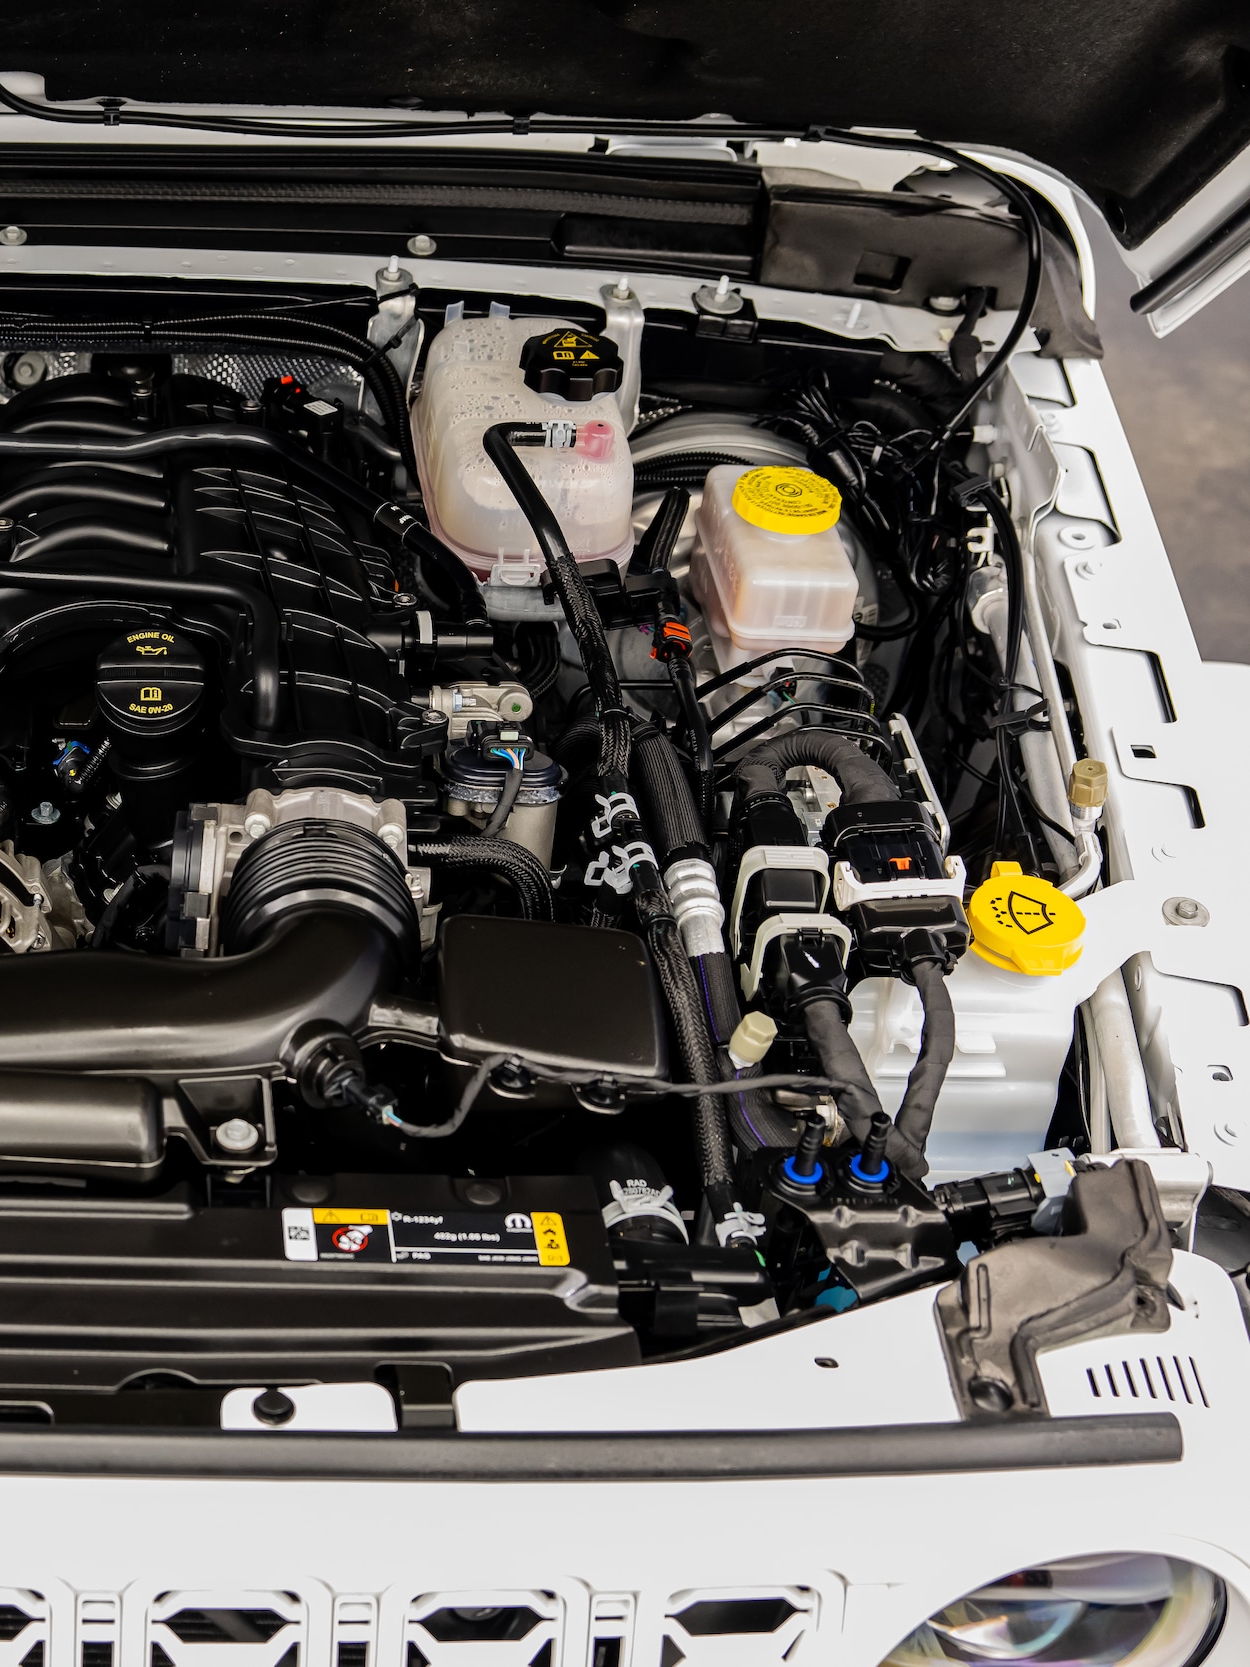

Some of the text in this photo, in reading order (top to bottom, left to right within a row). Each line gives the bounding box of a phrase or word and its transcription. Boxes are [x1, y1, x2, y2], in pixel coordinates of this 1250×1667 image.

[127, 632, 175, 643] ENGINE OIL
[129, 703, 173, 714] SAE 0W-20
[626, 1179, 647, 1187] RAD
